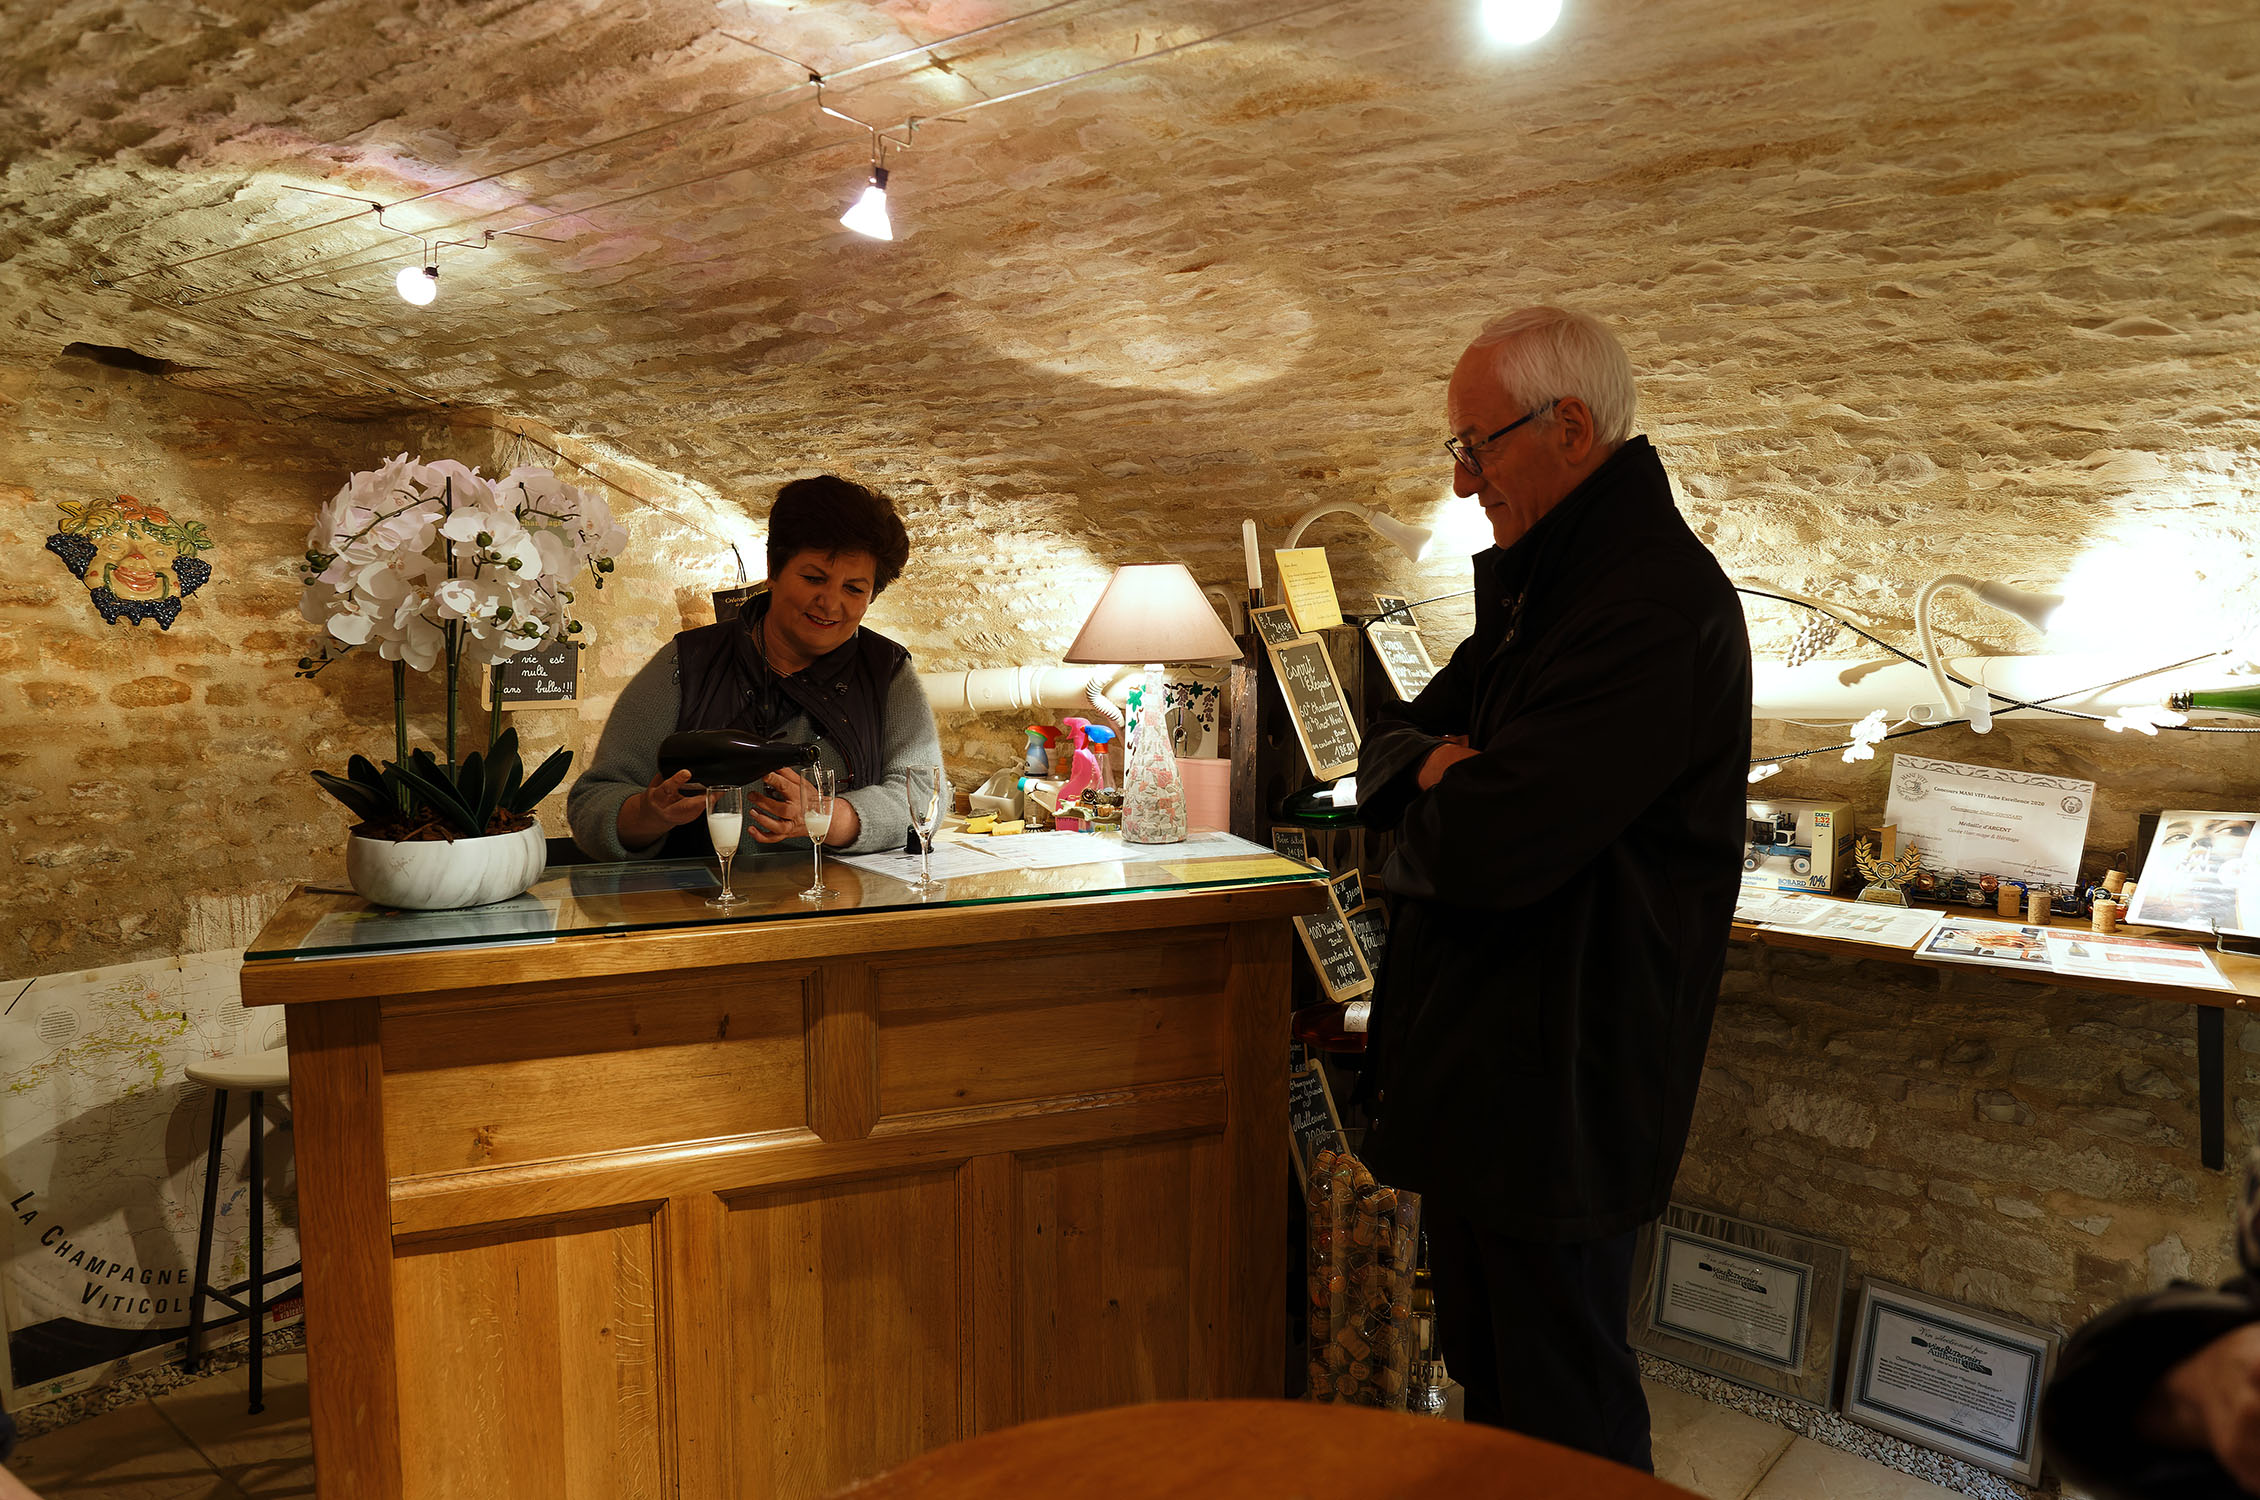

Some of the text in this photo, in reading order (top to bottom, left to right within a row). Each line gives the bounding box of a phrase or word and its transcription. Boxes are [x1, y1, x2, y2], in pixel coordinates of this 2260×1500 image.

[521, 654, 538, 663] vie
[549, 653, 565, 664] est
[521, 665, 548, 677] nulle
[1281, 652, 1315, 688] Esprit
[503, 686, 521, 694] ans
[1311, 701, 1344, 716] Chardonnay
[1329, 714, 1343, 726] Noir
[1933, 786, 1958, 794] Concours
[2001, 795, 2029, 804] Excellence
[10, 1190, 38, 1225] LA
[40, 1225, 188, 1285] CHAMPAGNE
